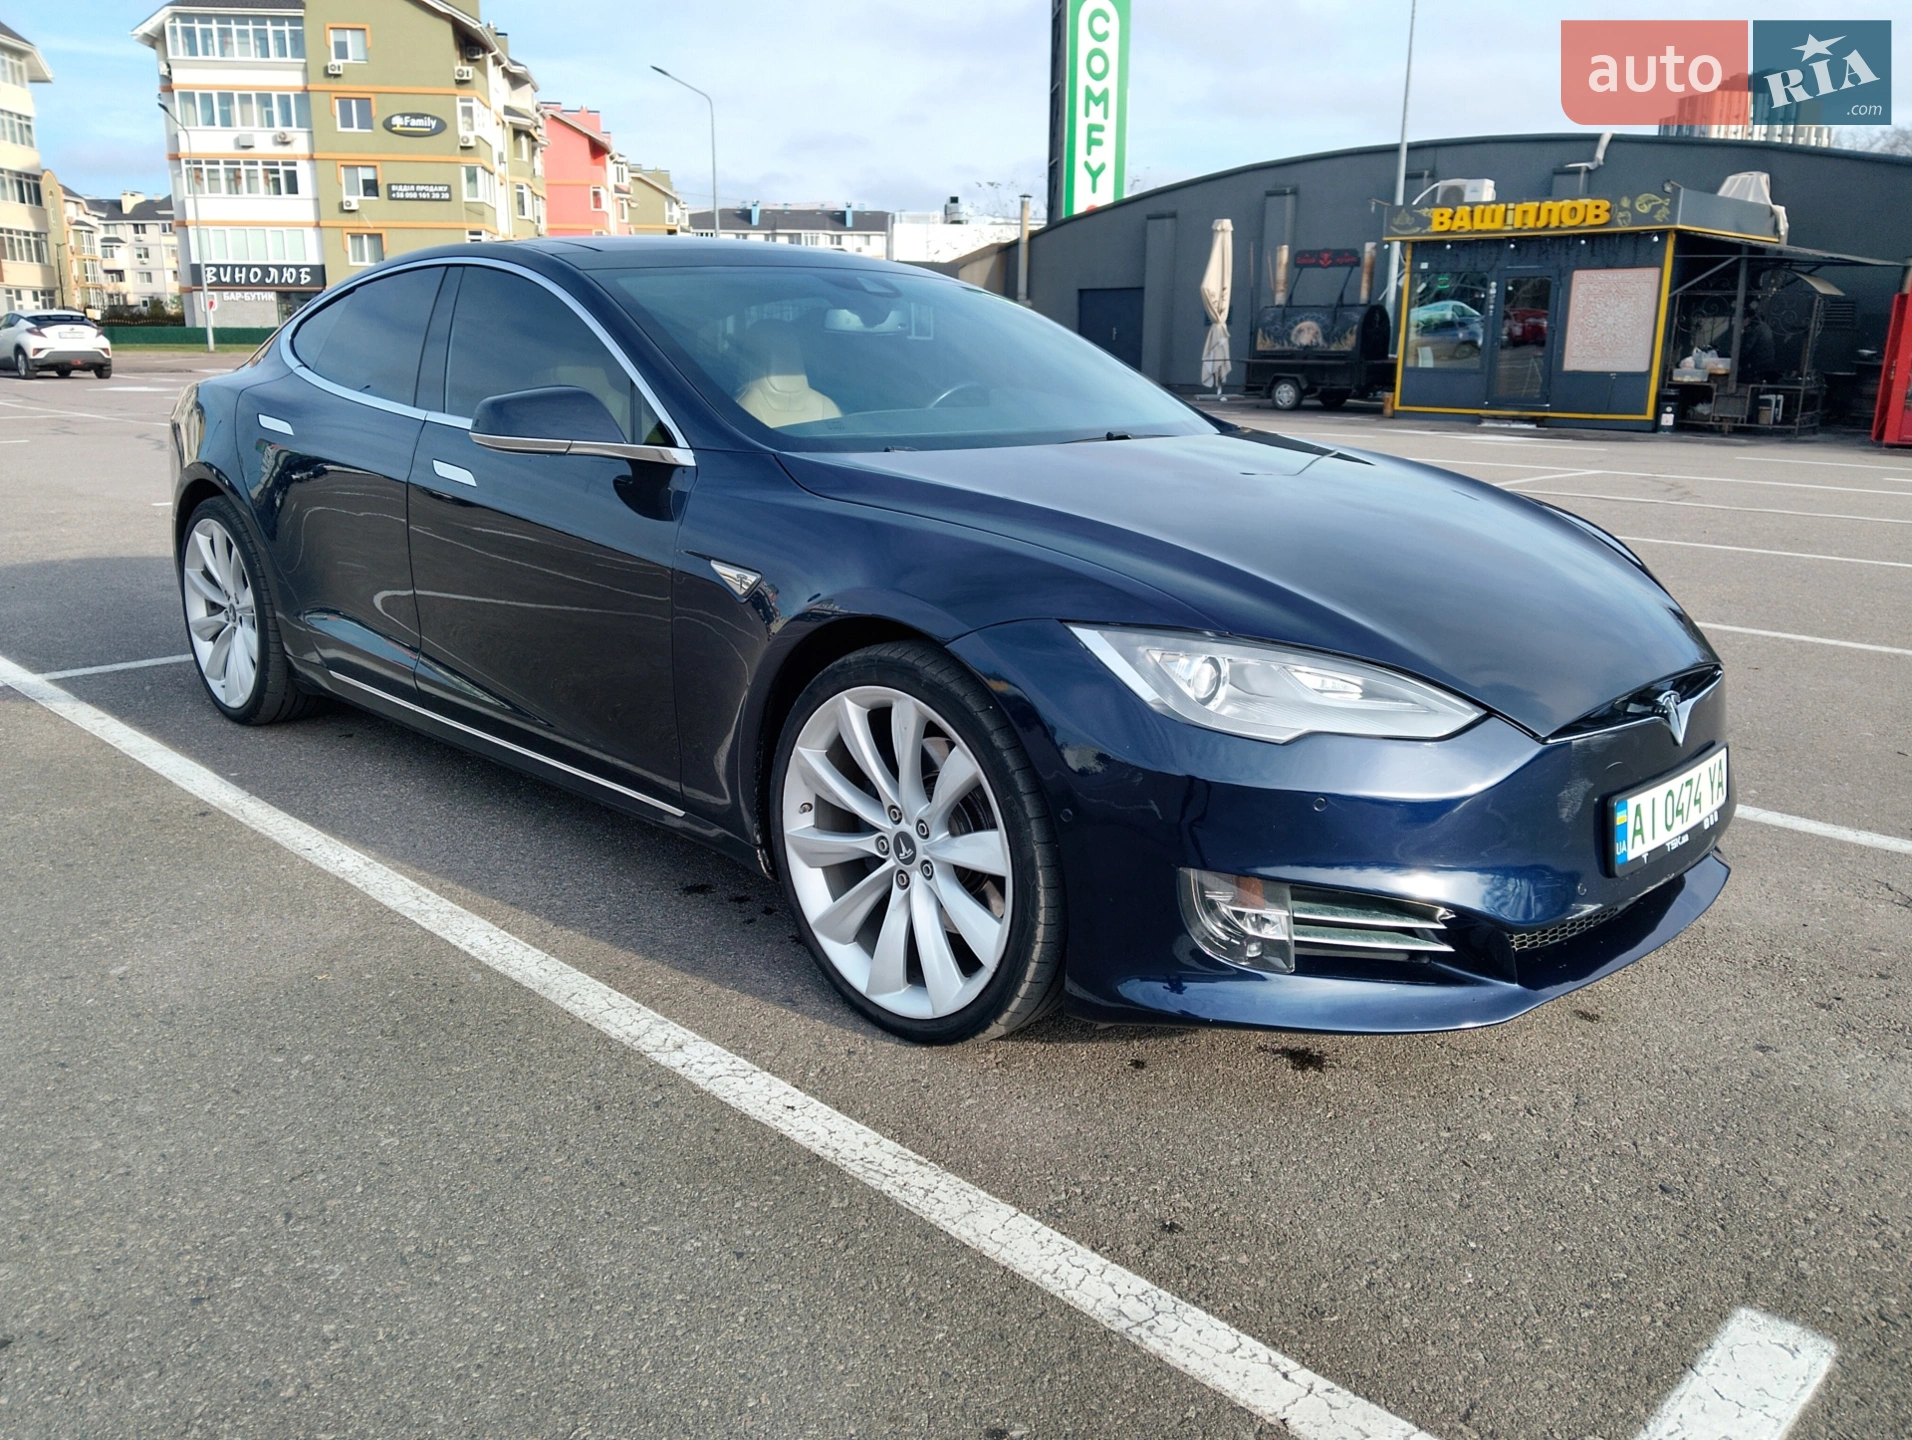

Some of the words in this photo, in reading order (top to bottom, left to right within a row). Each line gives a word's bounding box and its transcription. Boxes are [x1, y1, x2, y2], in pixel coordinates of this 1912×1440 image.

[1084, 7, 1111, 195] COMFY
[404, 115, 437, 130] Family
[1432, 203, 1506, 233] ВАШ
[1513, 198, 1612, 229] ПЛОВ
[205, 265, 312, 285] ВИНОЛЮБ
[222, 291, 276, 302] БАР-БУТИК
[1631, 797, 1656, 850] AI
[1664, 773, 1702, 832] 0474
[1708, 758, 1725, 805] YA
[1616, 840, 1627, 855] UA
